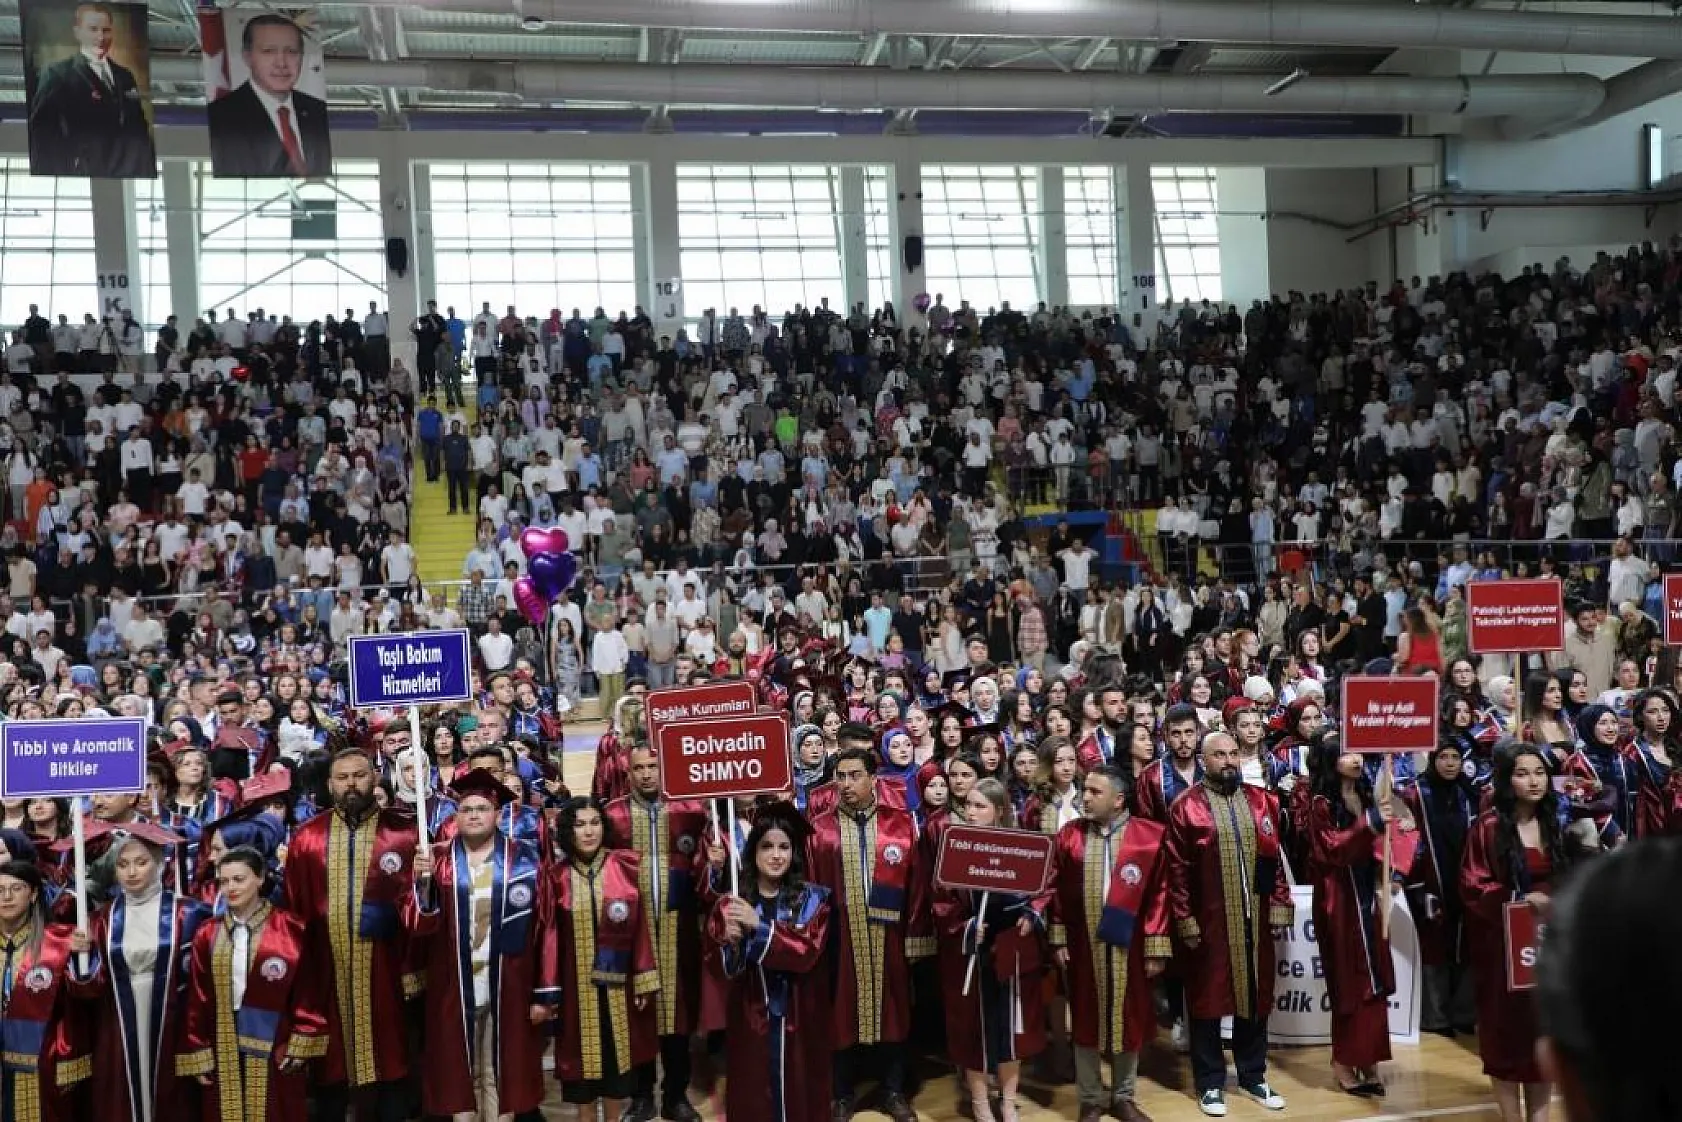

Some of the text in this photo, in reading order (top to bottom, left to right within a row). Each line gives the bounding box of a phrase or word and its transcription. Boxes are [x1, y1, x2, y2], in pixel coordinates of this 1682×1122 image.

[97, 274, 129, 289] 110
[655, 282, 681, 297] 10
[105, 297, 123, 313] K
[664, 303, 677, 319] J
[376, 642, 443, 671] Yaşlı Bakım
[382, 671, 441, 696] Hizmetleri
[692, 700, 750, 716] Kurumları
[52, 742, 68, 755] ve
[72, 737, 135, 755] Aromatik
[682, 731, 765, 755] Bolvadin
[49, 761, 99, 778] Bitkiler
[688, 758, 762, 783] SHMYO
[1272, 990, 1313, 1013] dik
